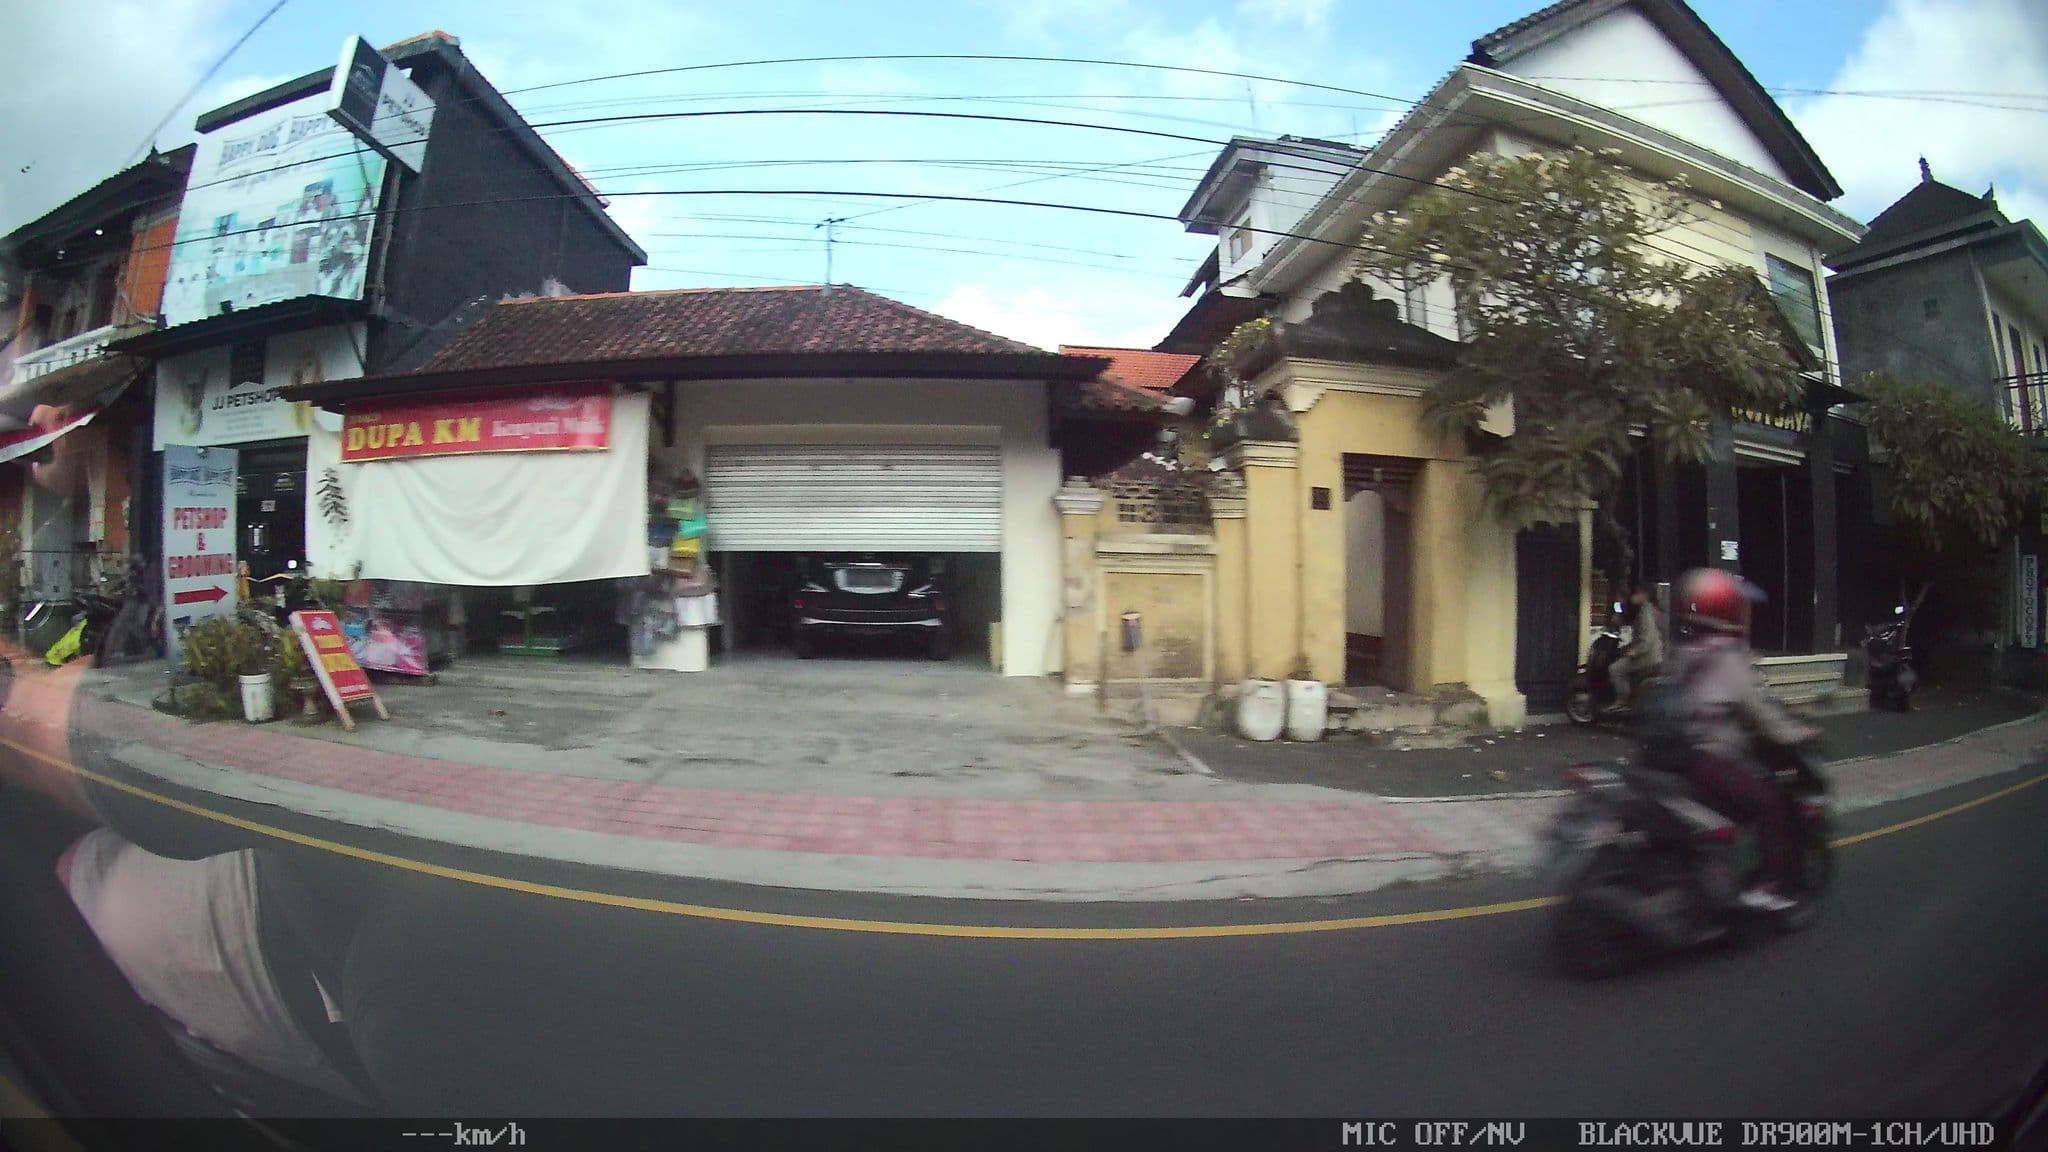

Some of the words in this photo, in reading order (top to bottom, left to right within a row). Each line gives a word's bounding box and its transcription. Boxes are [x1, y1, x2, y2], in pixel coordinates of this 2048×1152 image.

[212, 396, 224, 411] JJ
[346, 421, 424, 452] DUPA
[432, 417, 481, 445] KM
[174, 507, 228, 530] PETSHOP
[197, 532, 207, 551] &
[168, 553, 233, 579] GROOMING
